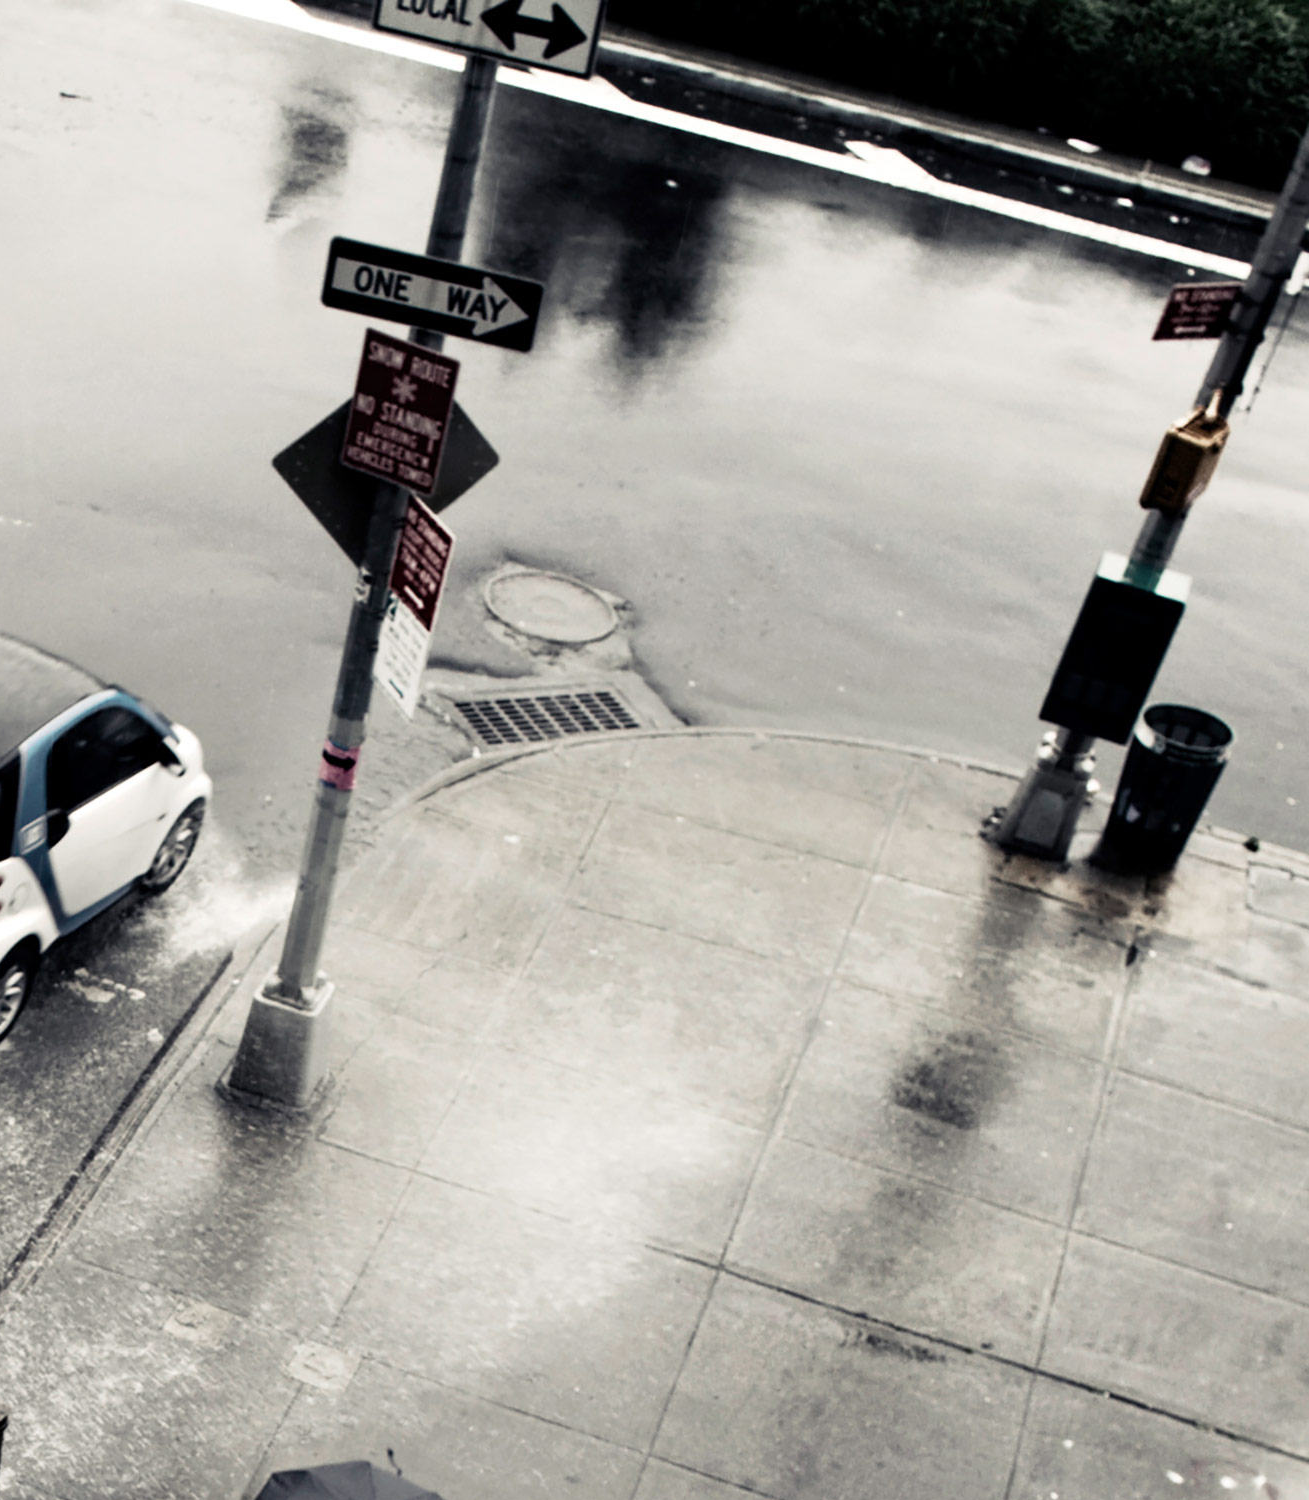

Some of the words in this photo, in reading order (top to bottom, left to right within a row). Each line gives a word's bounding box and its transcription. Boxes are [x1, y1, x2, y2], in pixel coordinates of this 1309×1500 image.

[354, 266, 413, 302] ONE
[447, 285, 508, 323] WAY
[368, 341, 407, 370] SNOW
[410, 356, 452, 388] ROUTE
[355, 393, 376, 415] NO
[380, 401, 443, 441] STANDING
[373, 421, 418, 449] DURING
[347, 446, 394, 473] VEHICLES
[398, 463, 433, 487] TOWED
[356, 431, 430, 468] EMERGENCY
